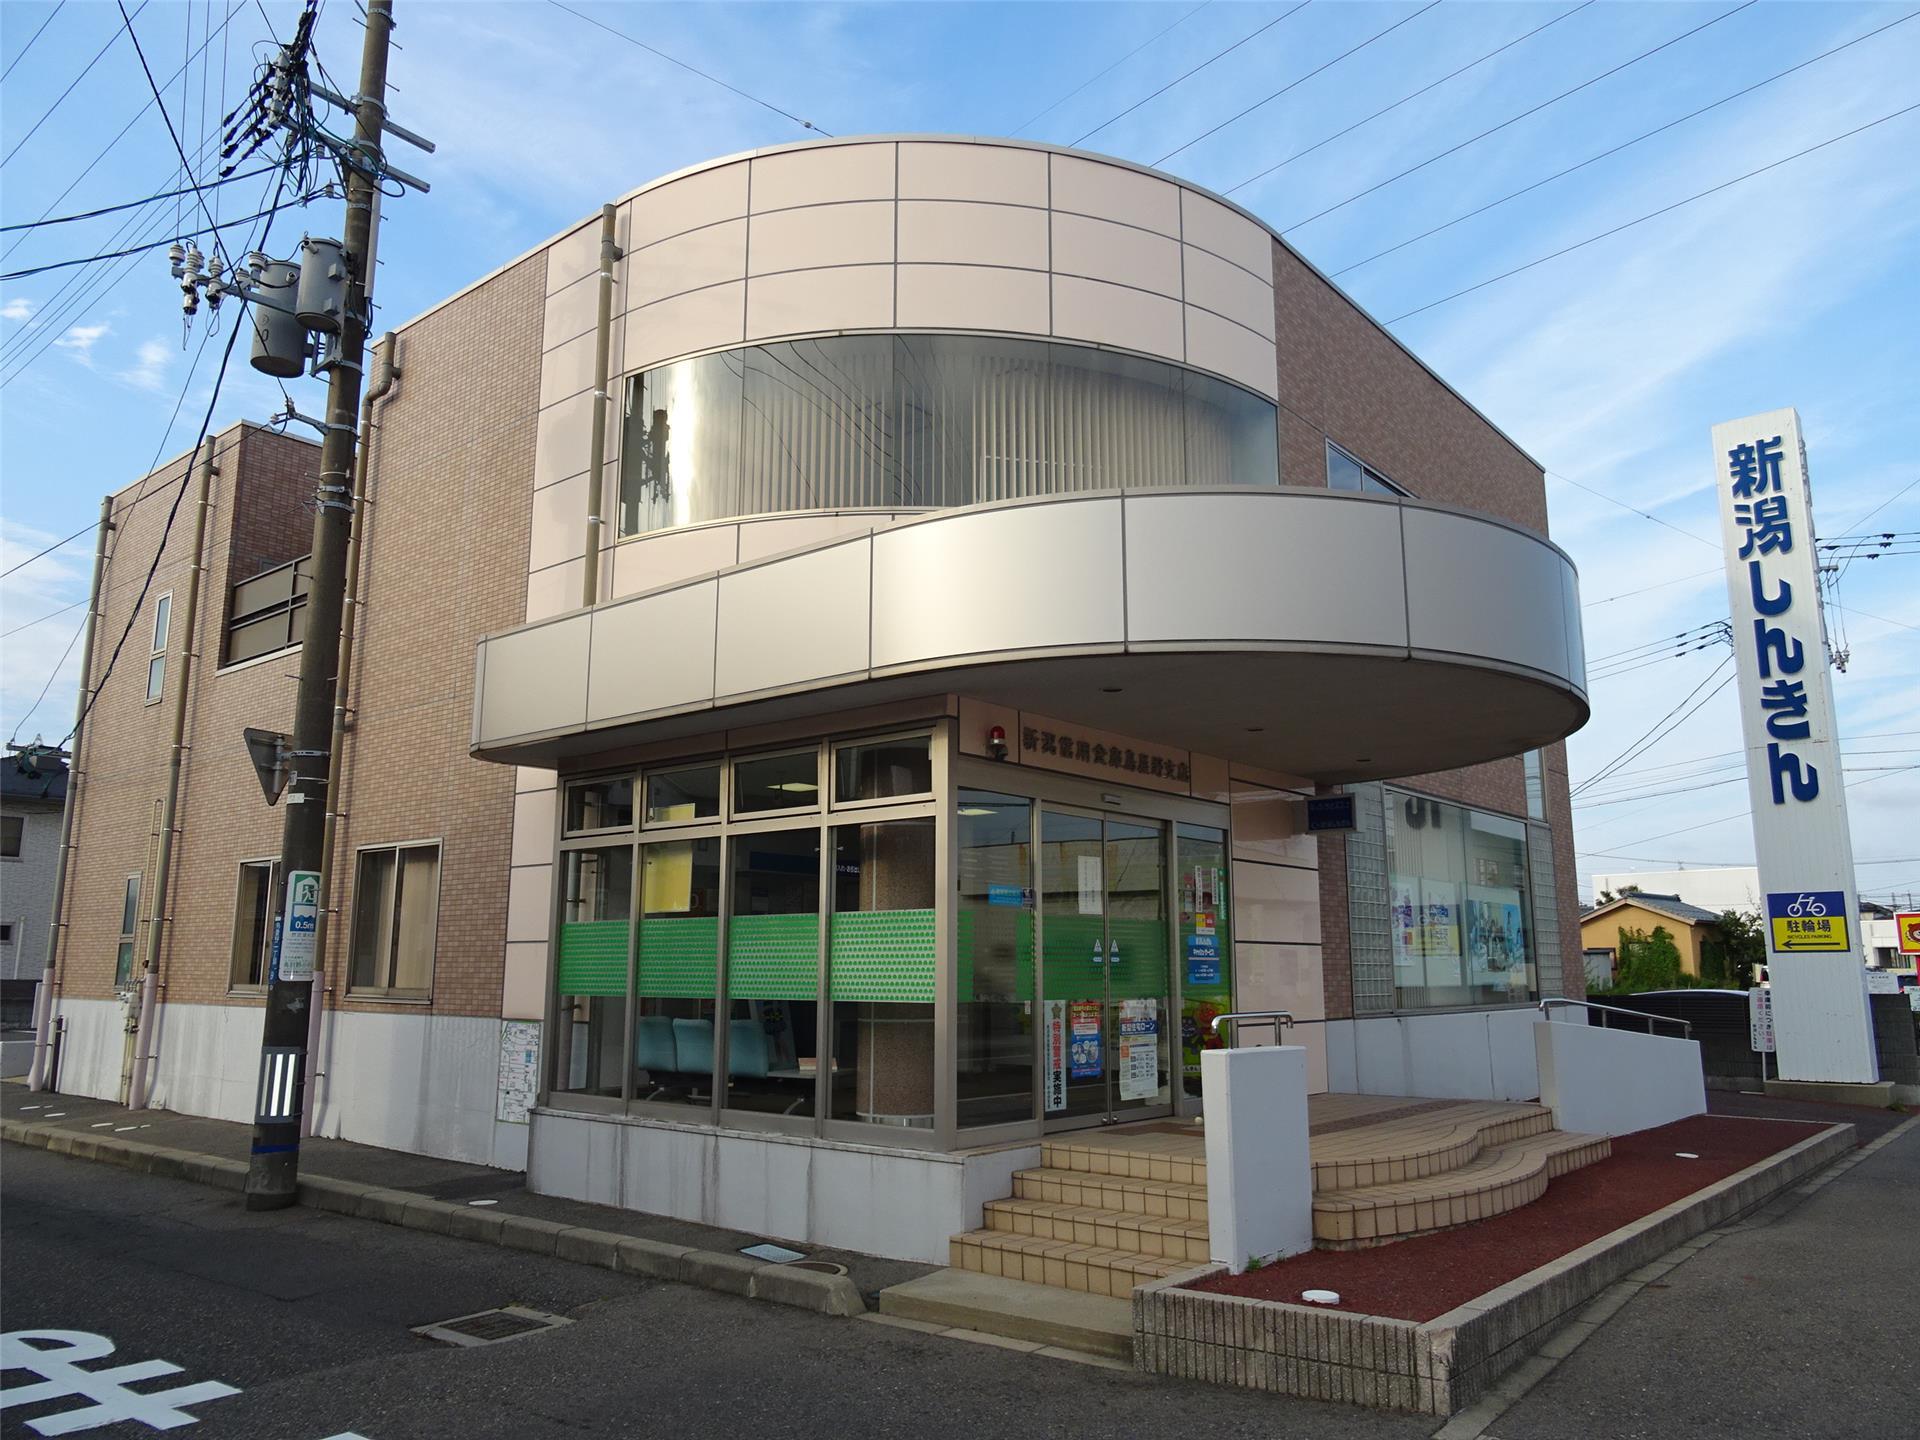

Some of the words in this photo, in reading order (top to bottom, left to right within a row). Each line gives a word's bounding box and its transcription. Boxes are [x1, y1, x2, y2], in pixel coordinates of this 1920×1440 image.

[1727, 435, 1819, 805] 新潟しんきん
[1787, 919, 1832, 933] 駐輪場
